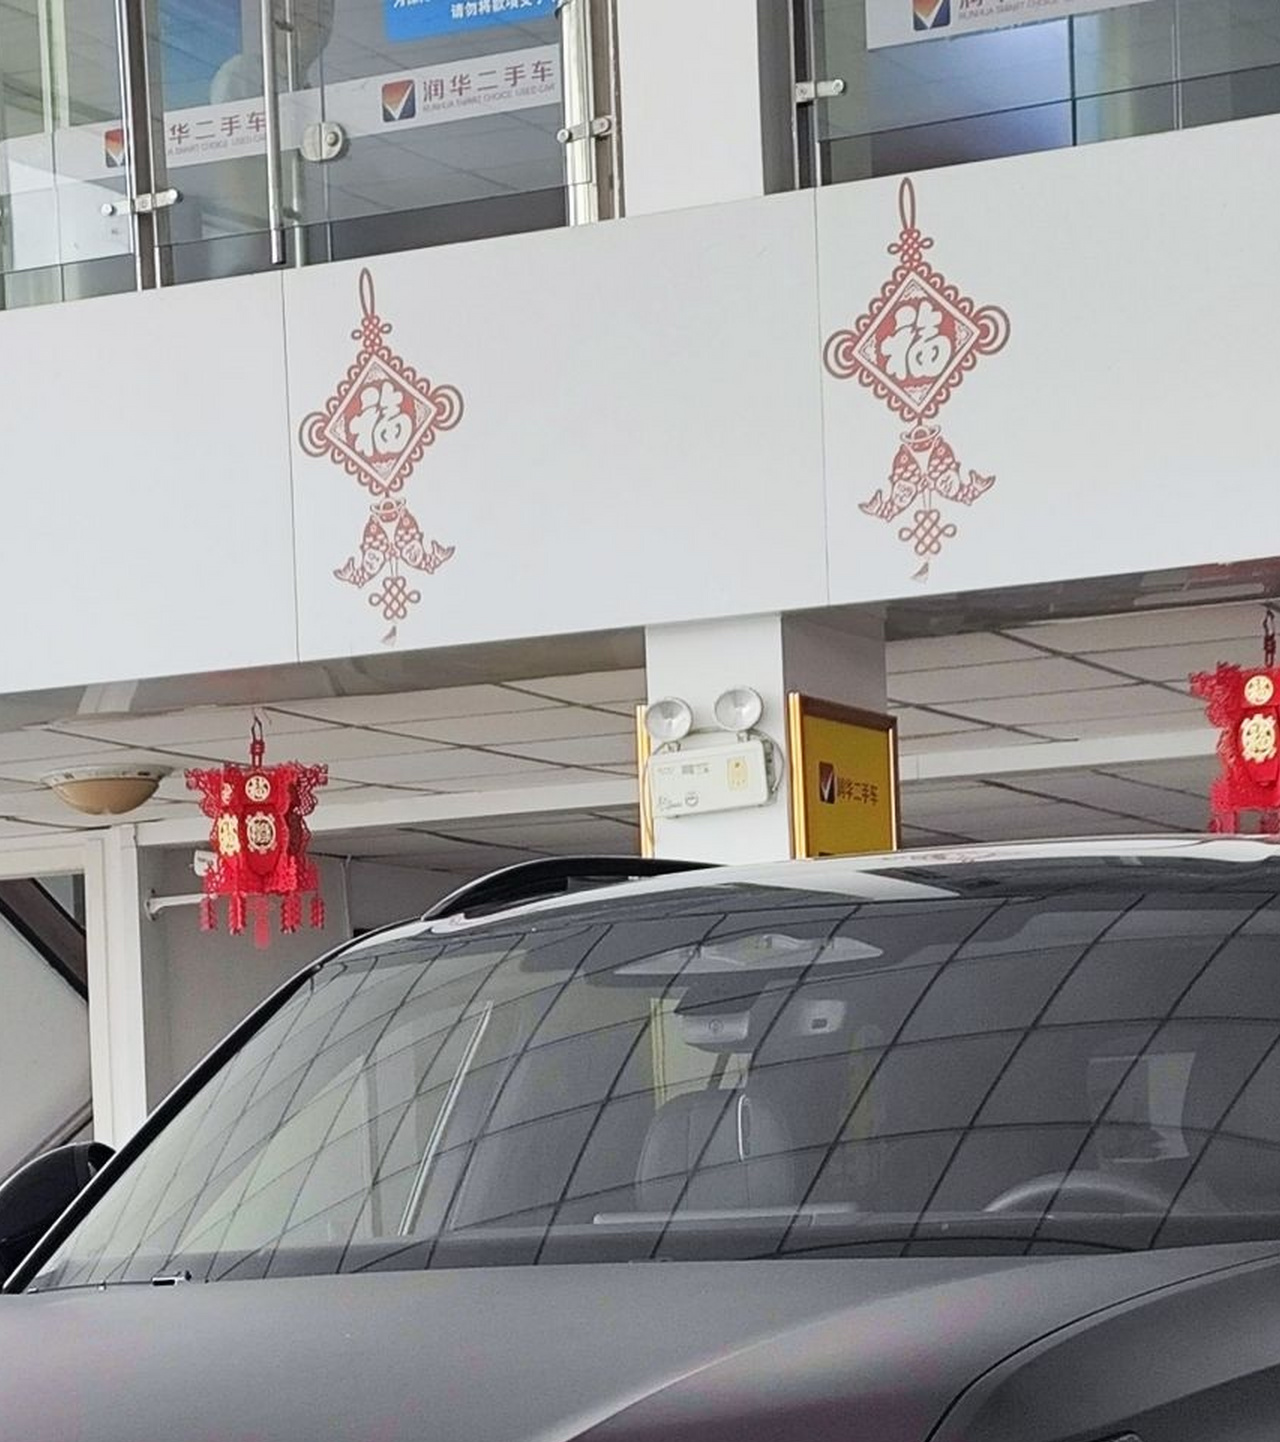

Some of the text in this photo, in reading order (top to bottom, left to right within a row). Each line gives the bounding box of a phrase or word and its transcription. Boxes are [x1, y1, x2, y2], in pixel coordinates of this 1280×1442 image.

[422, 60, 555, 102] 润华二手车
[169, 111, 266, 144] 华二手车
[881, 301, 951, 380] 福
[349, 382, 412, 457] 福
